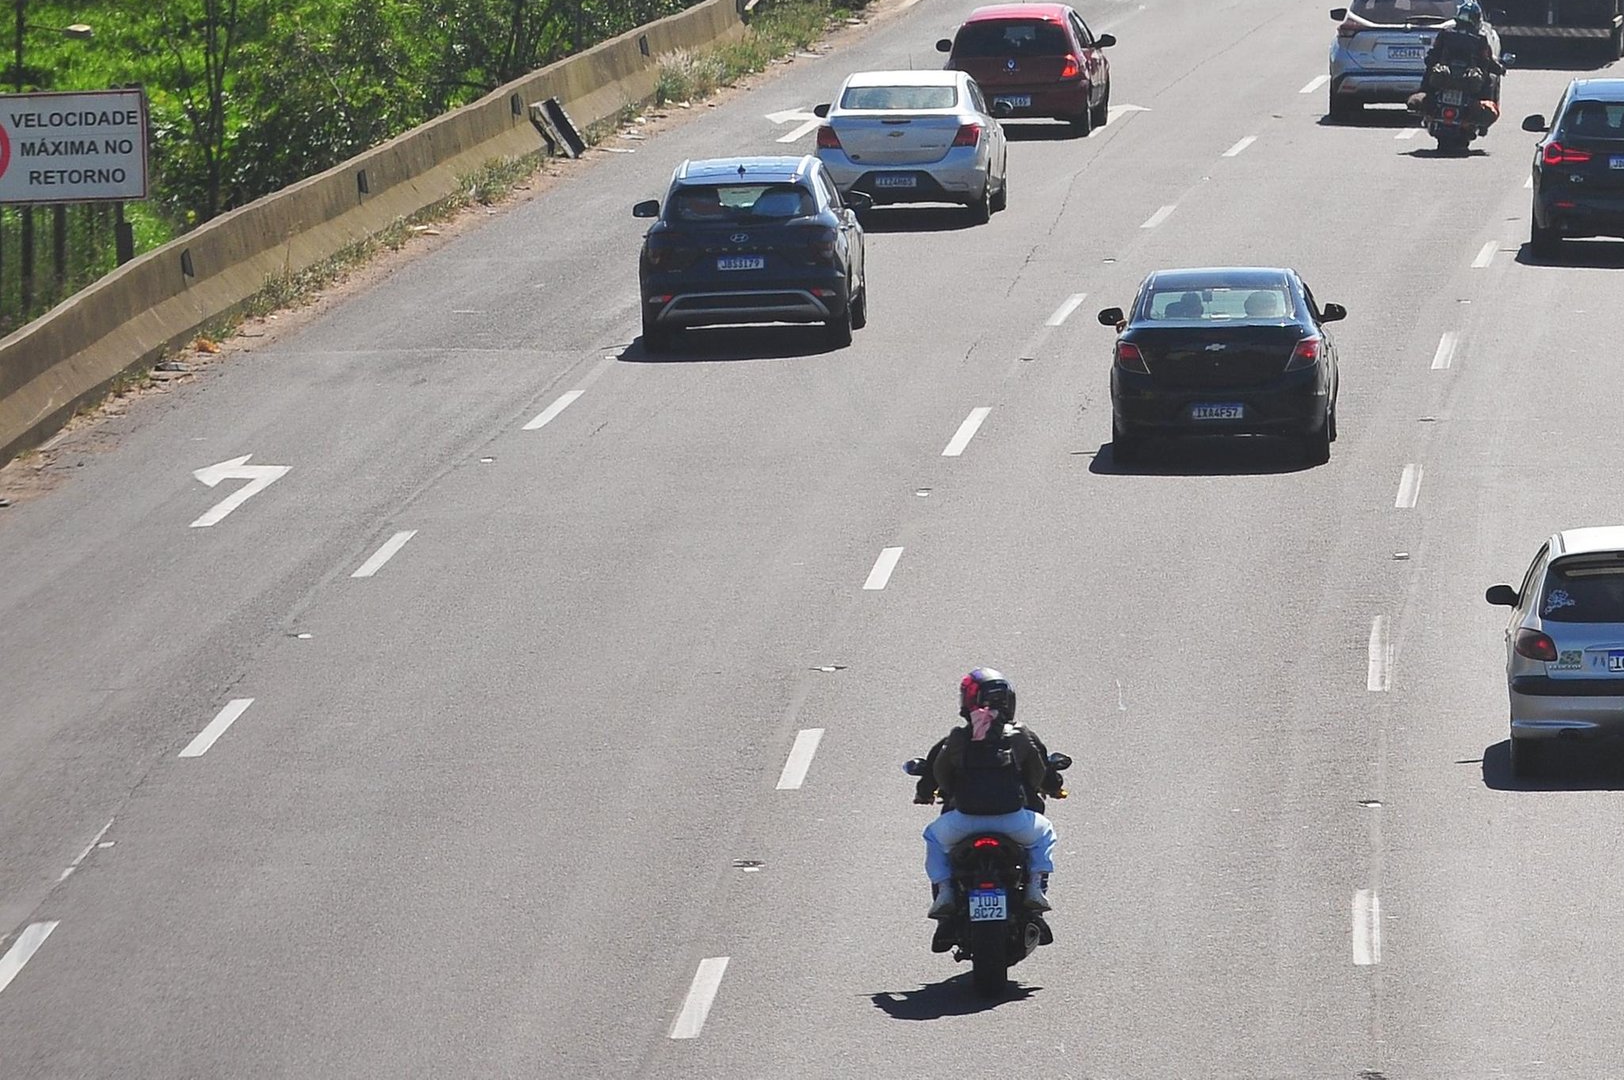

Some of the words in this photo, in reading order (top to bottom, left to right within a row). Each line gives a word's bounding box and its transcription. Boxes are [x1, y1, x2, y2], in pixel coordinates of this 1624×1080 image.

[11, 110, 138, 128] VELOCIDADE
[20, 138, 99, 156] MÁXIMA
[105, 139, 133, 155] NO
[29, 168, 126, 185] RETORNO
